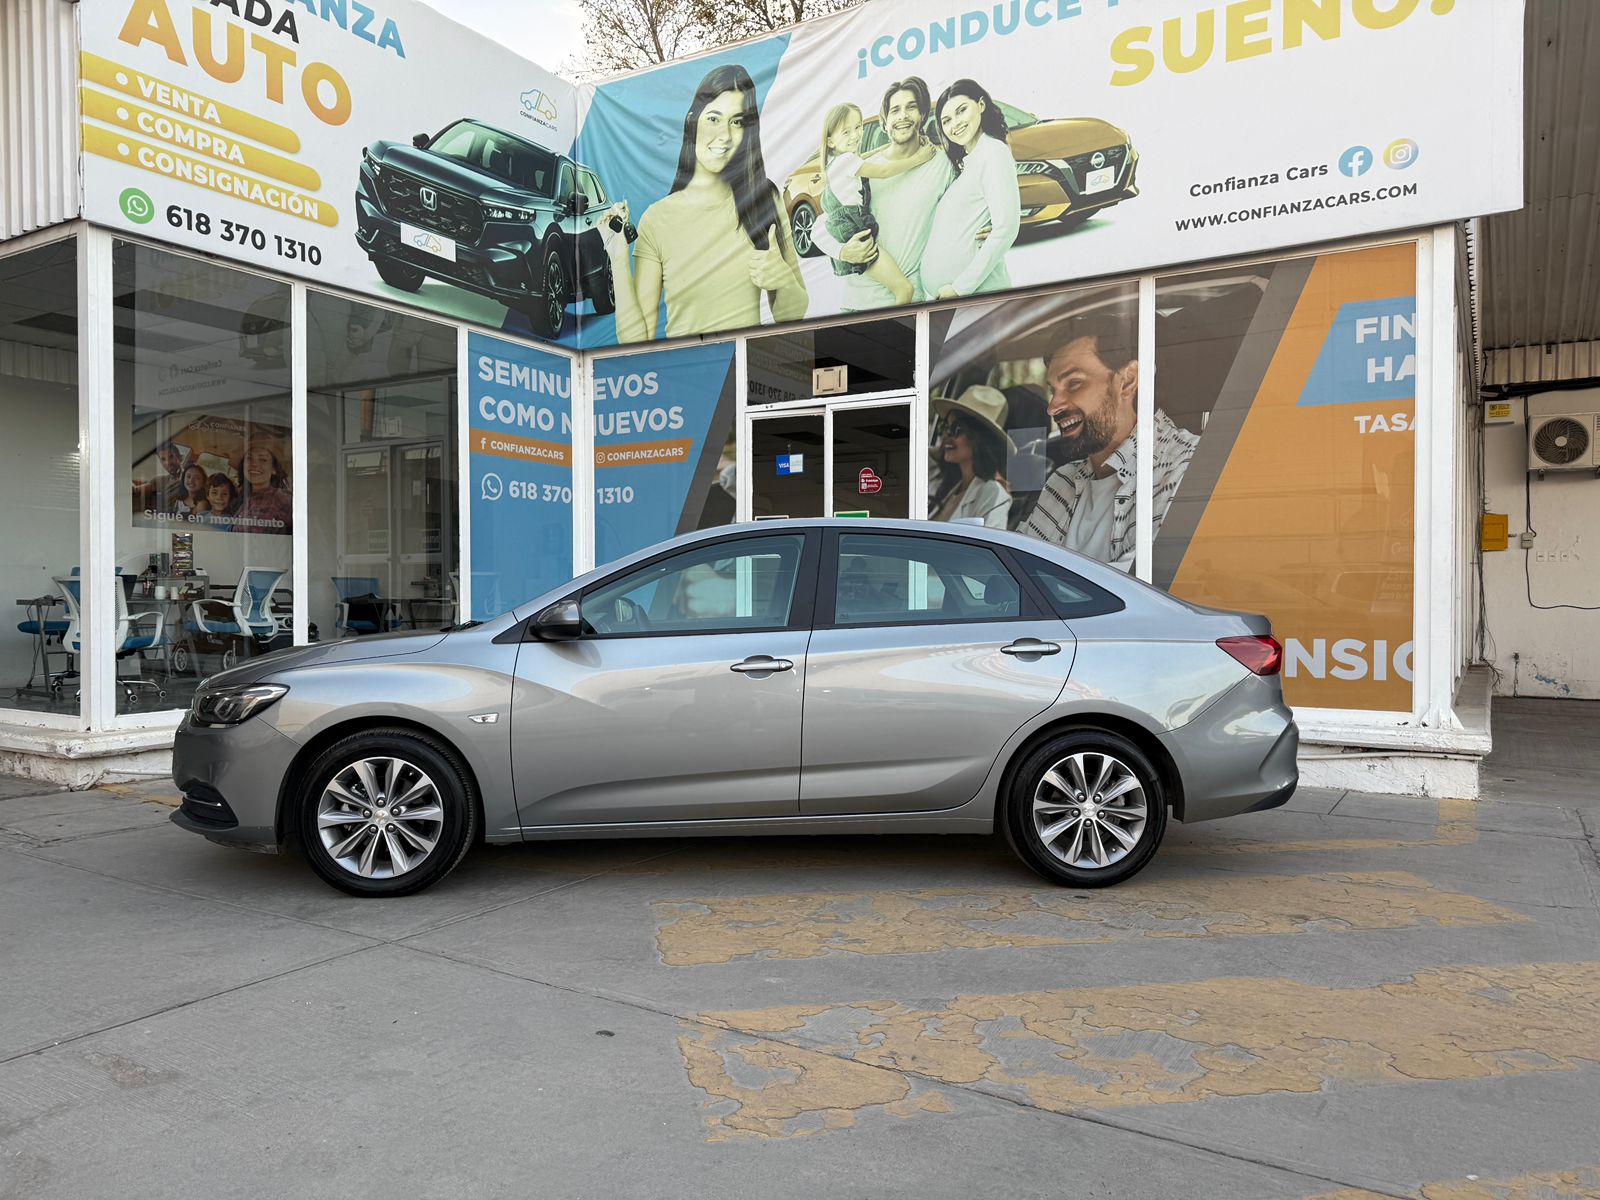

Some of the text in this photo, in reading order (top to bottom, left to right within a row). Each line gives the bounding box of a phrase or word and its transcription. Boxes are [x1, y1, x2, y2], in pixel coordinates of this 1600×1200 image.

[117, 0, 352, 126] AUTO
[136, 76, 222, 124] VENTA
[137, 112, 246, 165] COMPRA
[138, 149, 319, 219] CONSIGNACIÓN
[1189, 162, 1329, 197] Confianza Cars
[1175, 183, 1418, 232] WWW.CONFIANZACARS.COM
[166, 205, 322, 266] 618 370 1310
[1356, 312, 1416, 344] FIN
[479, 396, 555, 431] COMO
[490, 440, 565, 461] CONFIANZACARS
[607, 447, 684, 462] CONFIANZACARS
[508, 480, 634, 504] 618 370 1310
[144, 509, 285, 528] Sigue en movimiento
